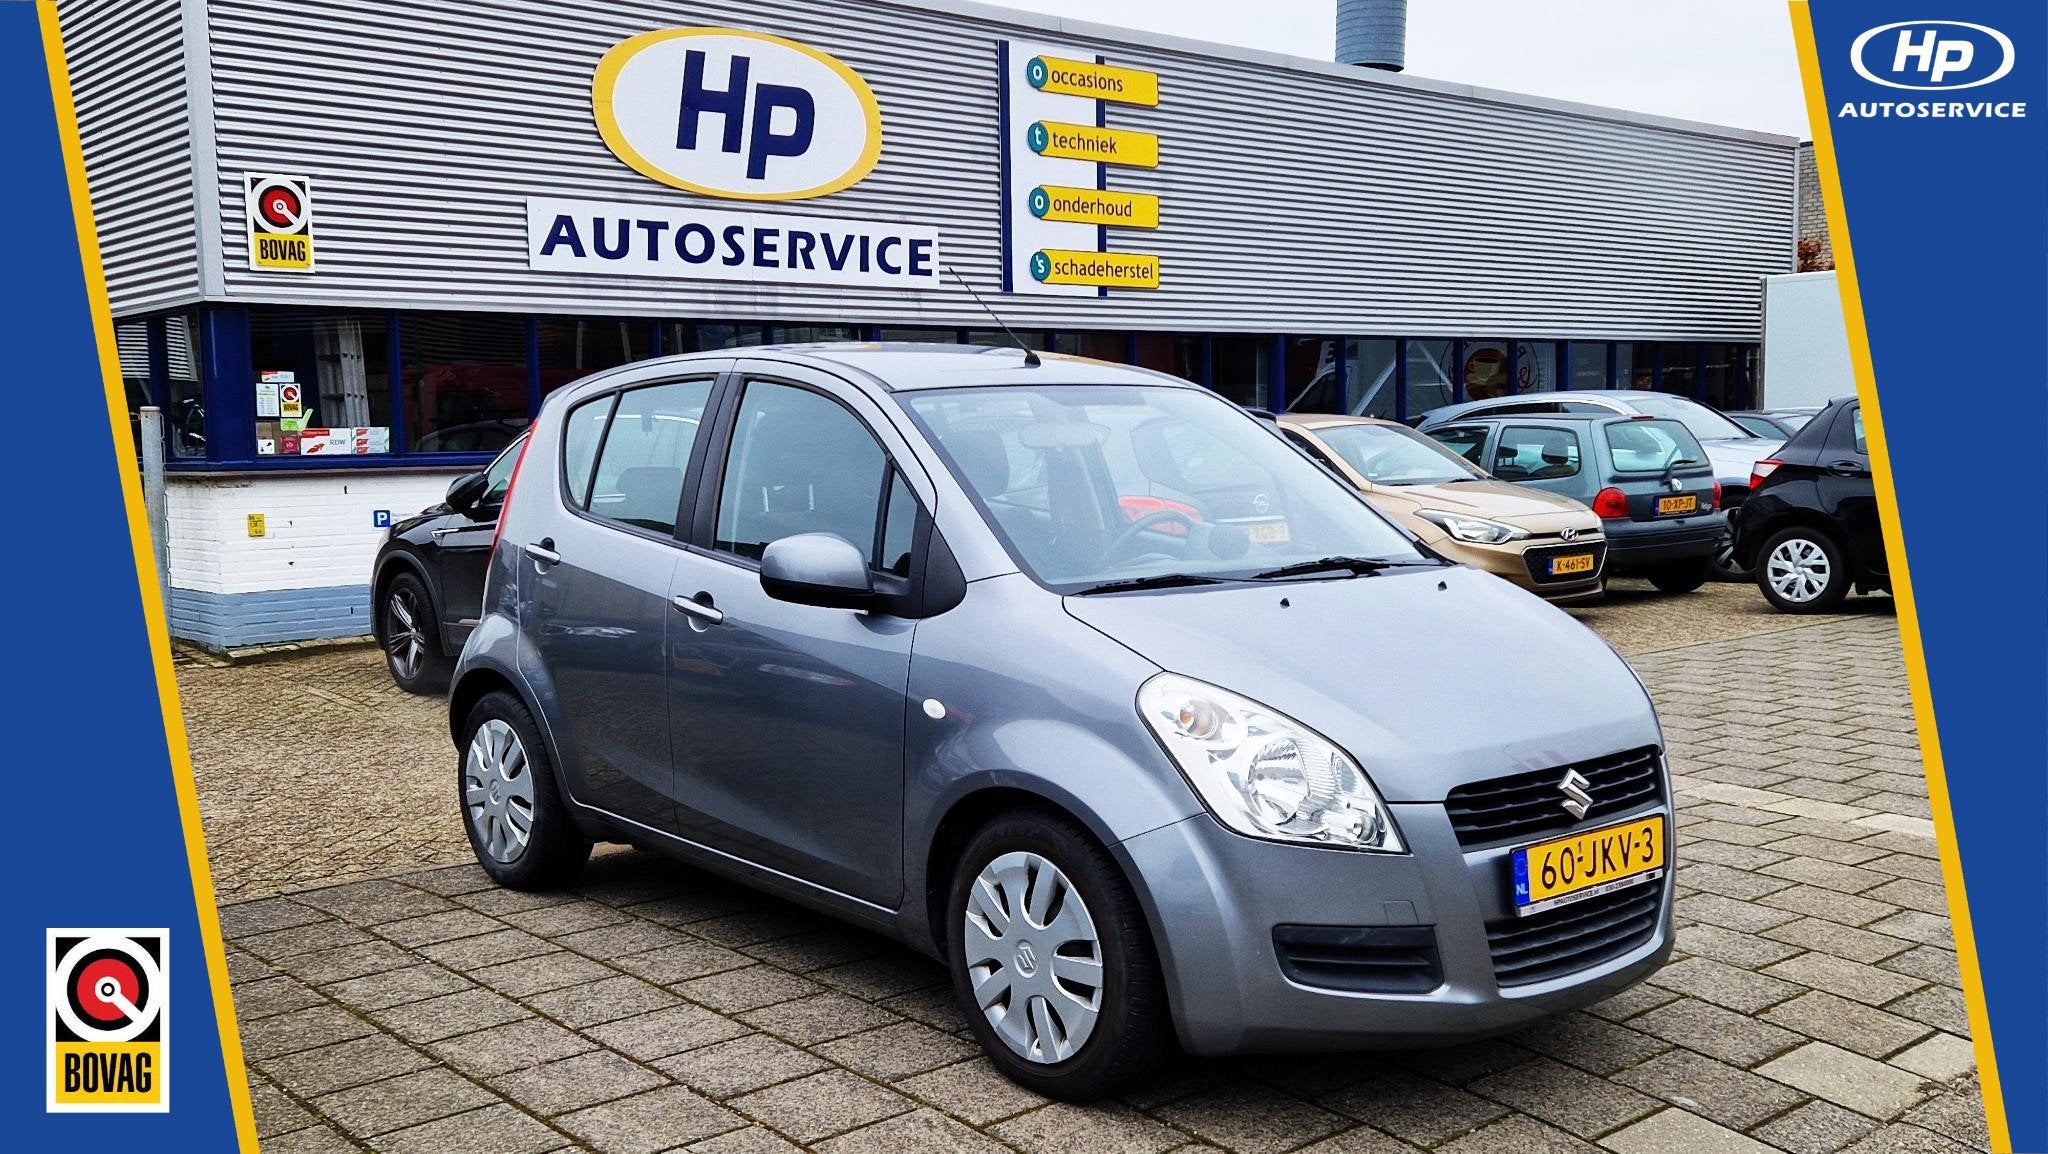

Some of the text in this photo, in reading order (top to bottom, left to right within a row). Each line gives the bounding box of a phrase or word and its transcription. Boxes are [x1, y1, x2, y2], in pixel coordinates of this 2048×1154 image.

[1051, 70, 1123, 92] occasions
[1053, 131, 1117, 154] techniek
[1053, 196, 1132, 217] onderhoud
[259, 238, 306, 262] BOVAG
[540, 214, 933, 276] AUTOSERVICE
[1054, 258, 1153, 279] schadeherstel
[377, 511, 388, 526] P
[1556, 557, 1590, 572] K-461-SV
[1516, 883, 1528, 896] NL
